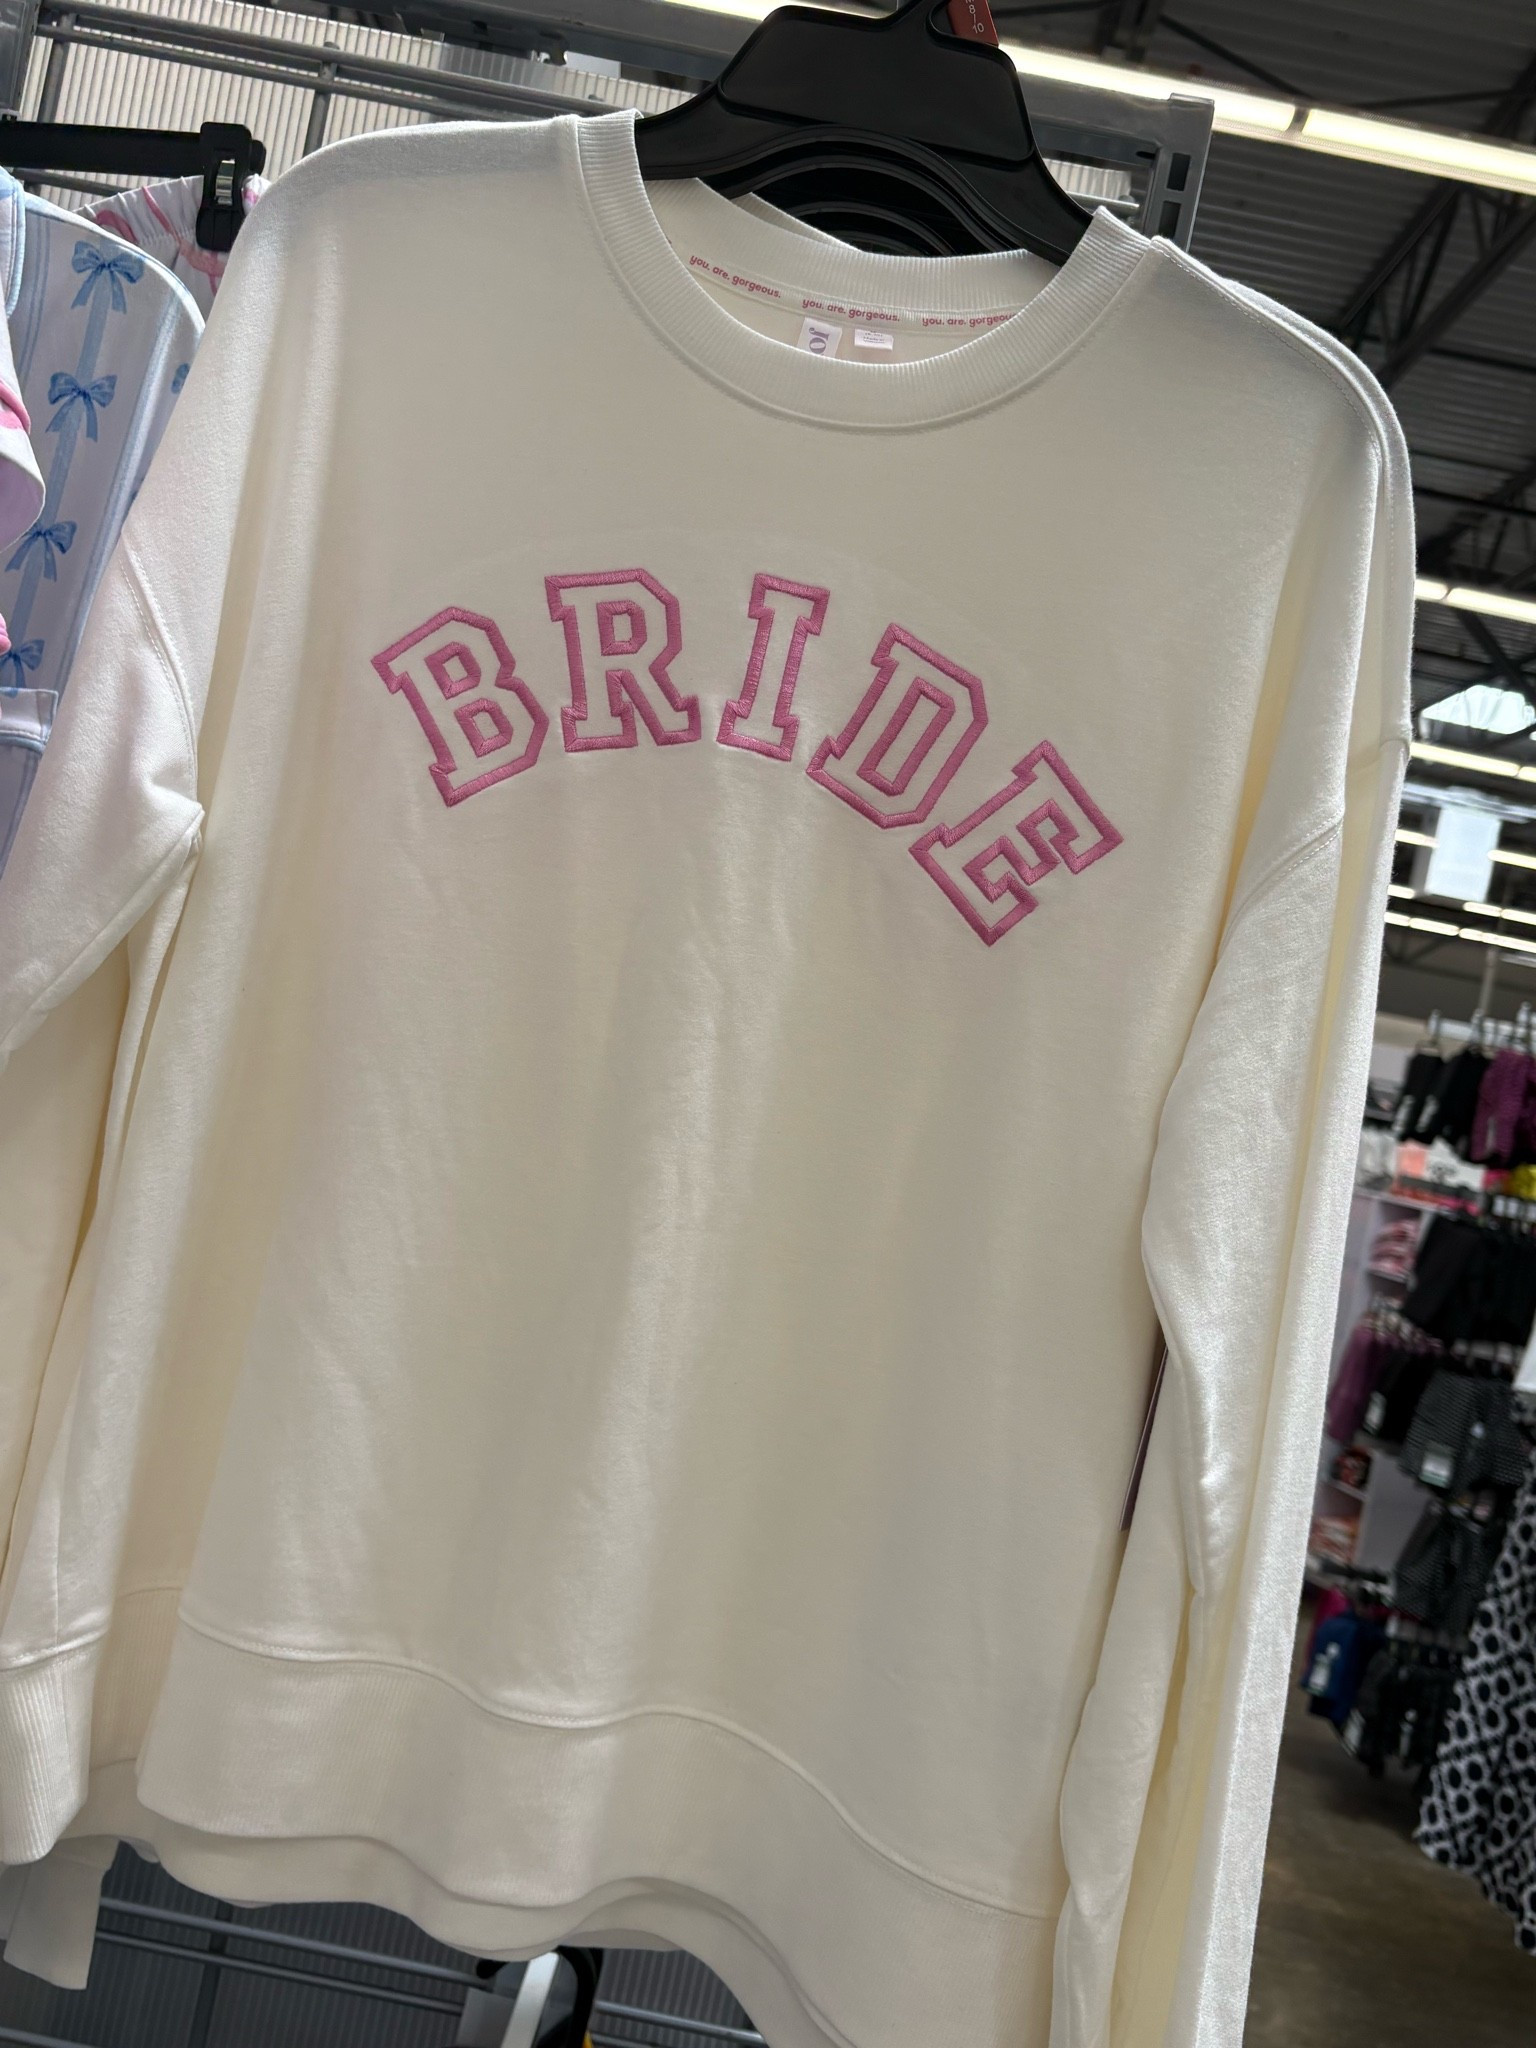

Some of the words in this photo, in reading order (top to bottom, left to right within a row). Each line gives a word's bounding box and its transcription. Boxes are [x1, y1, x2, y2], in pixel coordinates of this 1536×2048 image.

[968, 4, 976, 14] 8
[689, 255, 710, 271] you.
[712, 266, 730, 281] are.
[731, 275, 781, 298] gorgeous.
[802, 299, 824, 310] you.
[827, 304, 846, 315] are.
[848, 308, 900, 322] gorgeous.
[921, 317, 945, 327] you.
[946, 318, 967, 326] are.
[968, 313, 1017, 328] gorgeou
[371, 567, 1124, 947] BRIDE
